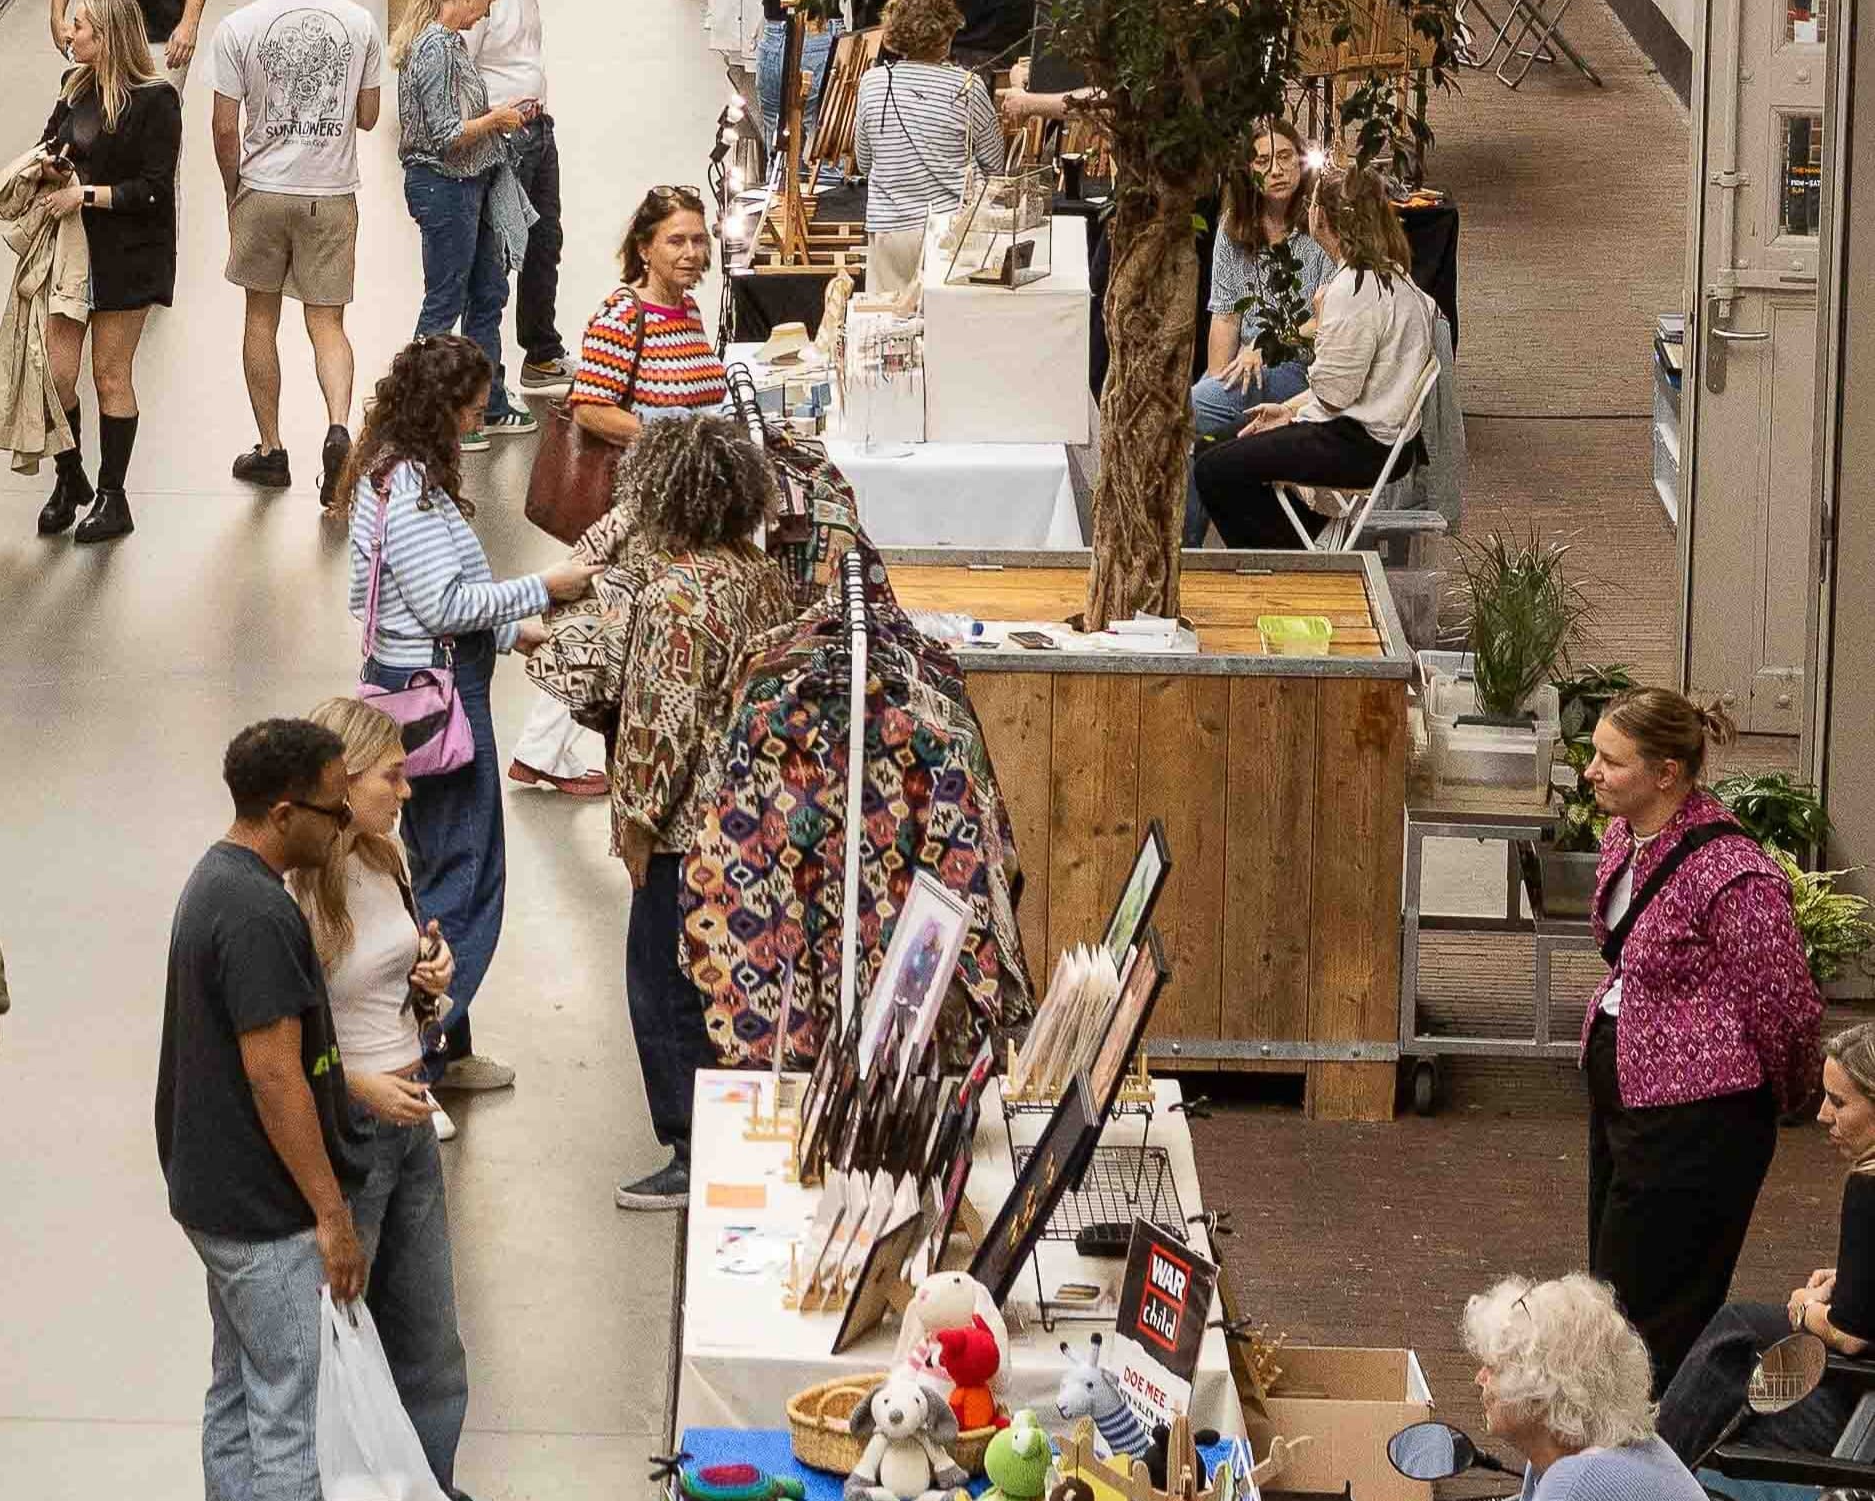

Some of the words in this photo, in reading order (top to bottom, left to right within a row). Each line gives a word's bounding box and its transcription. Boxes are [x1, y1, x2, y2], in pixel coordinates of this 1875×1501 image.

[1151, 1254, 1187, 1301] WAR
[1142, 1297, 1178, 1341] child
[1123, 1365, 1144, 1393] DOE
[1144, 1380, 1167, 1409] MEE
